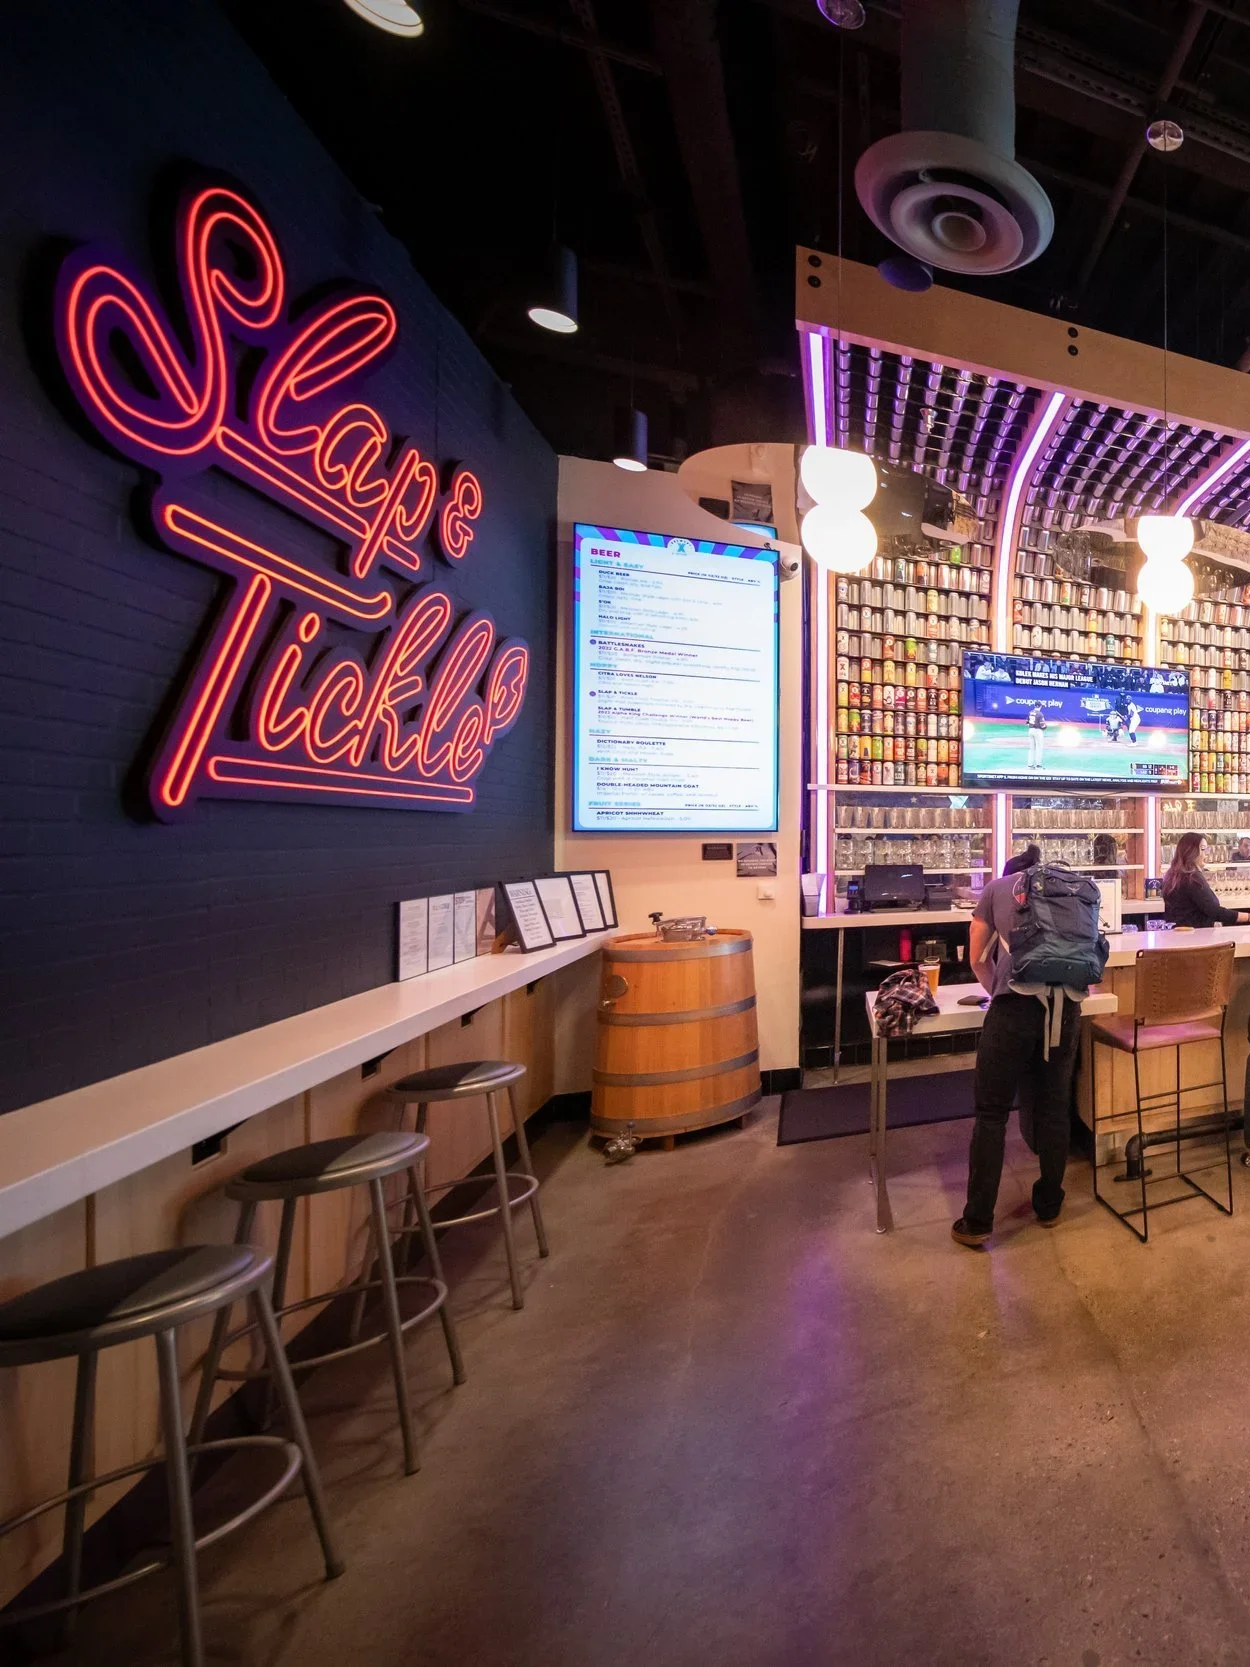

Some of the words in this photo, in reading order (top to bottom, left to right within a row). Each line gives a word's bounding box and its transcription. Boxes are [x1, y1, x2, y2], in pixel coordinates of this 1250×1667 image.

[68, 186, 437, 580] Slap
[440, 471, 482, 560] &
[590, 547, 621, 558] BEER
[598, 639, 644, 648] BATTLESNAKES
[163, 503, 484, 808] Tickle
[1015, 677, 1032, 685] DEBUT
[1032, 671, 1049, 679] MAKES
[1059, 673, 1075, 681] MAJOR
[1075, 675, 1094, 683] LEAGUE
[1048, 699, 1063, 709] play
[1145, 706, 1173, 716] coupang
[1173, 708, 1187, 717] play
